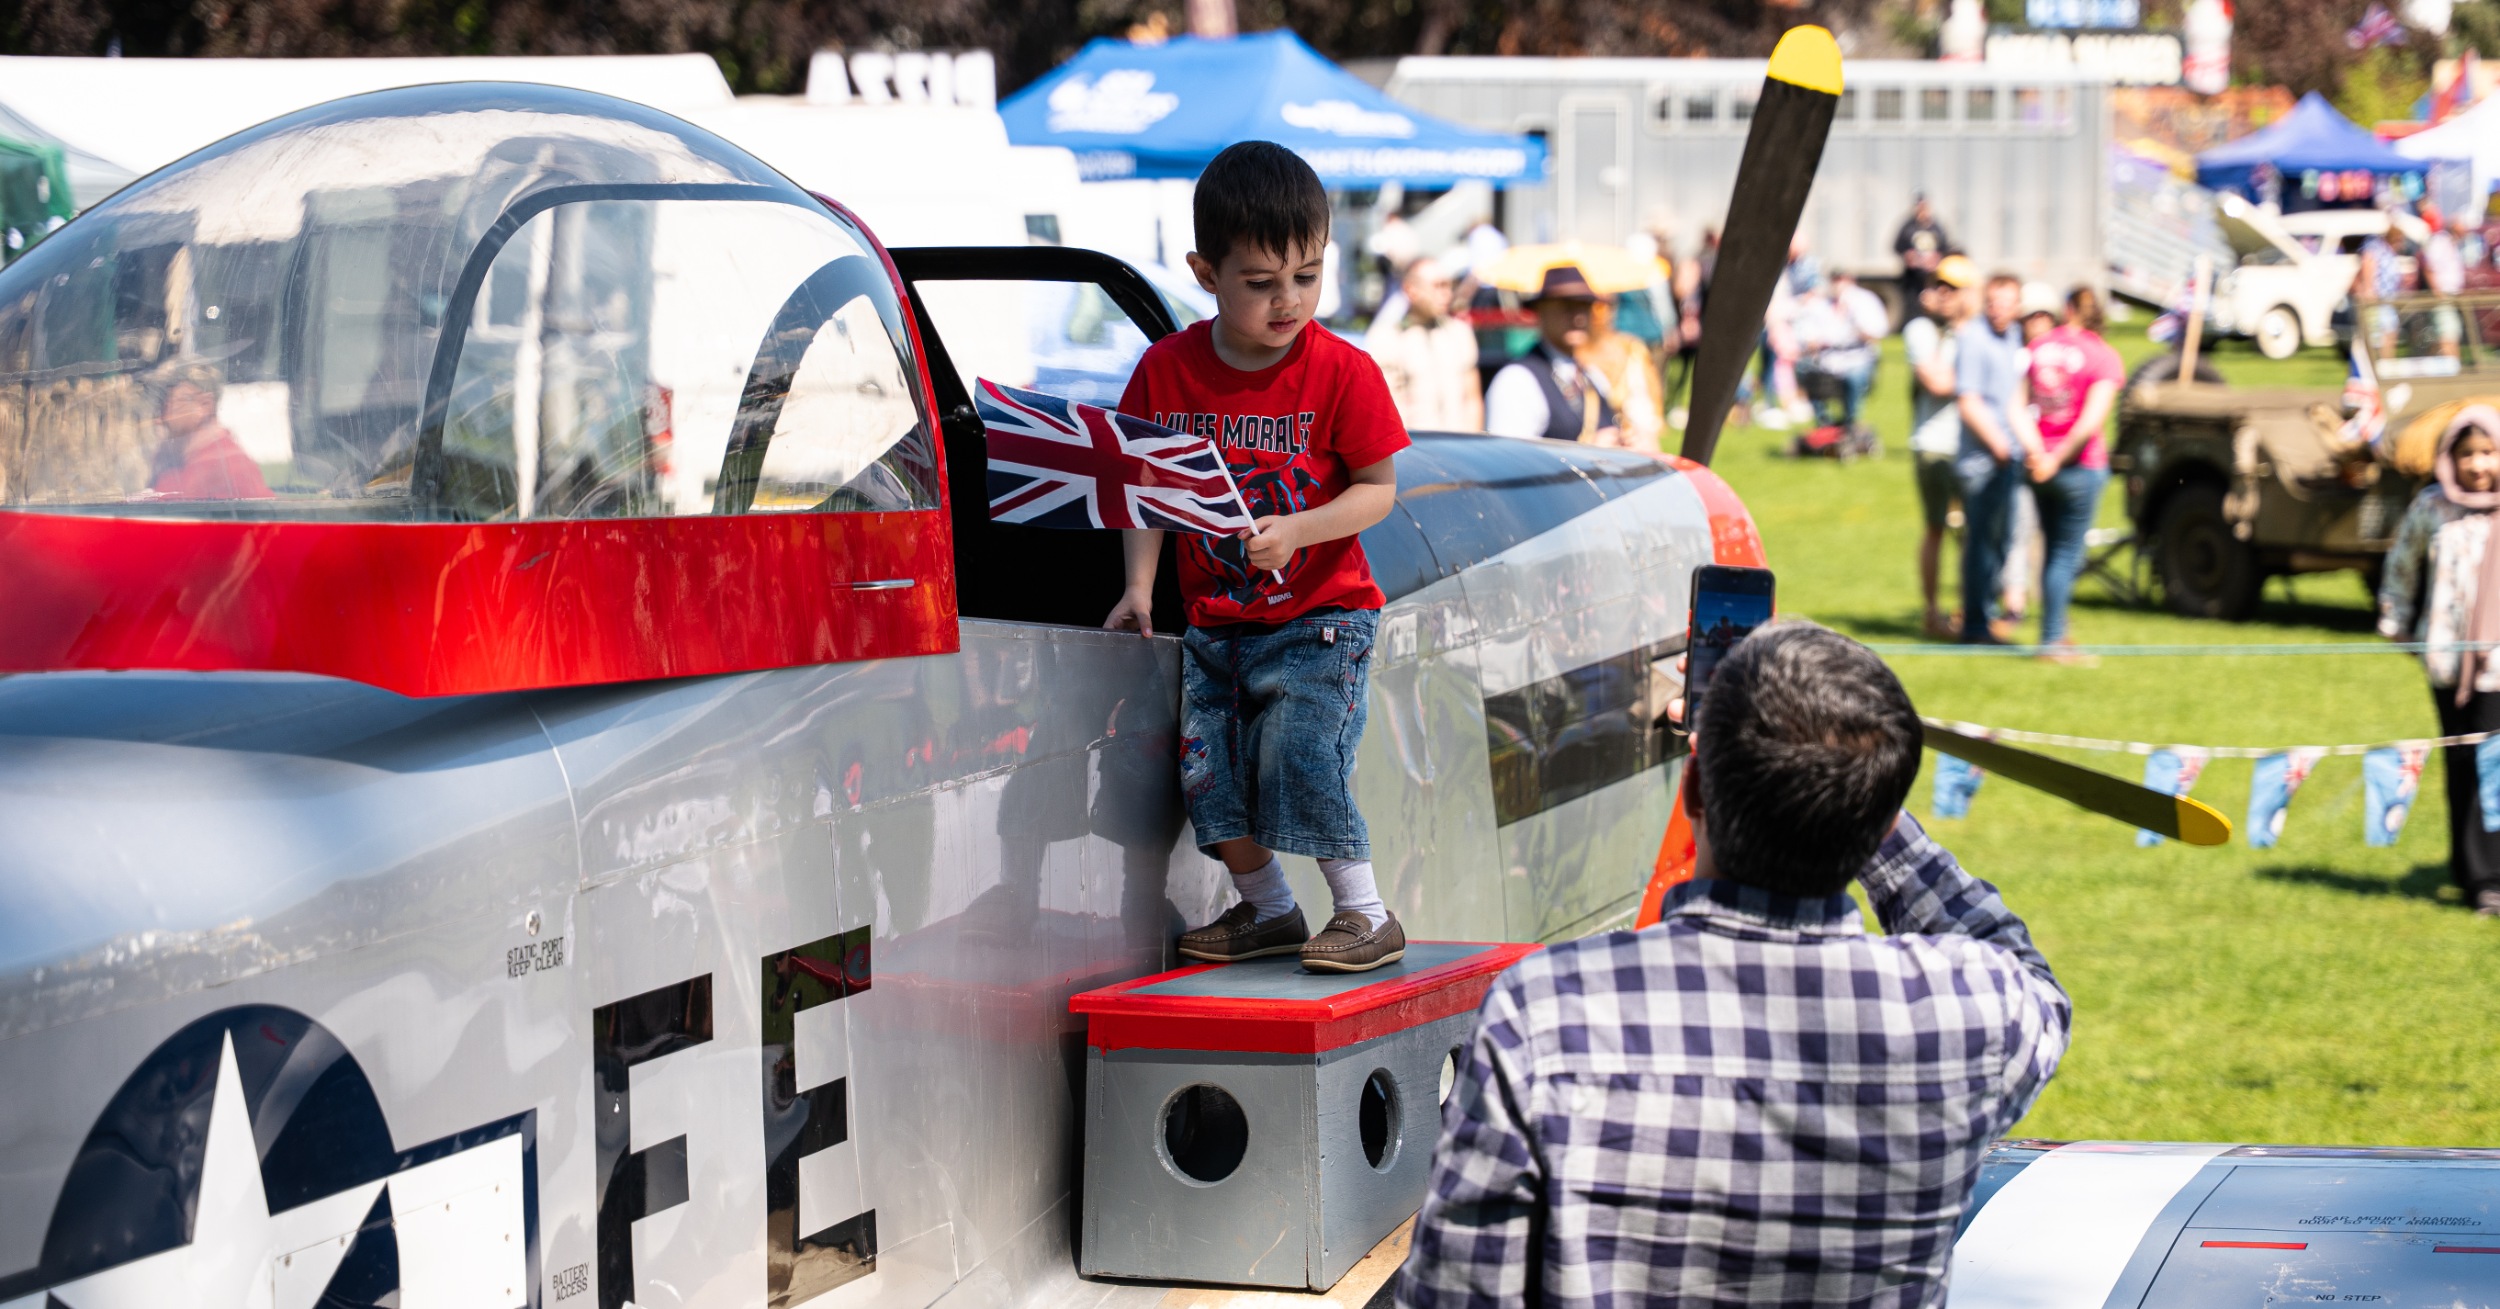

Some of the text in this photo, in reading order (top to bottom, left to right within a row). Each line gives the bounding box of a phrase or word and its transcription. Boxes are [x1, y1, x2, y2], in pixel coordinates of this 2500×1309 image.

[1267, 591, 1294, 605] MARVEL
[507, 937, 564, 965] STATIC PORT
[508, 952, 563, 978] KEEP CLEAR
[552, 1261, 590, 1290] BATTERY
[556, 1276, 588, 1303] ACCESS
[2343, 1294, 2382, 1302] STEP
